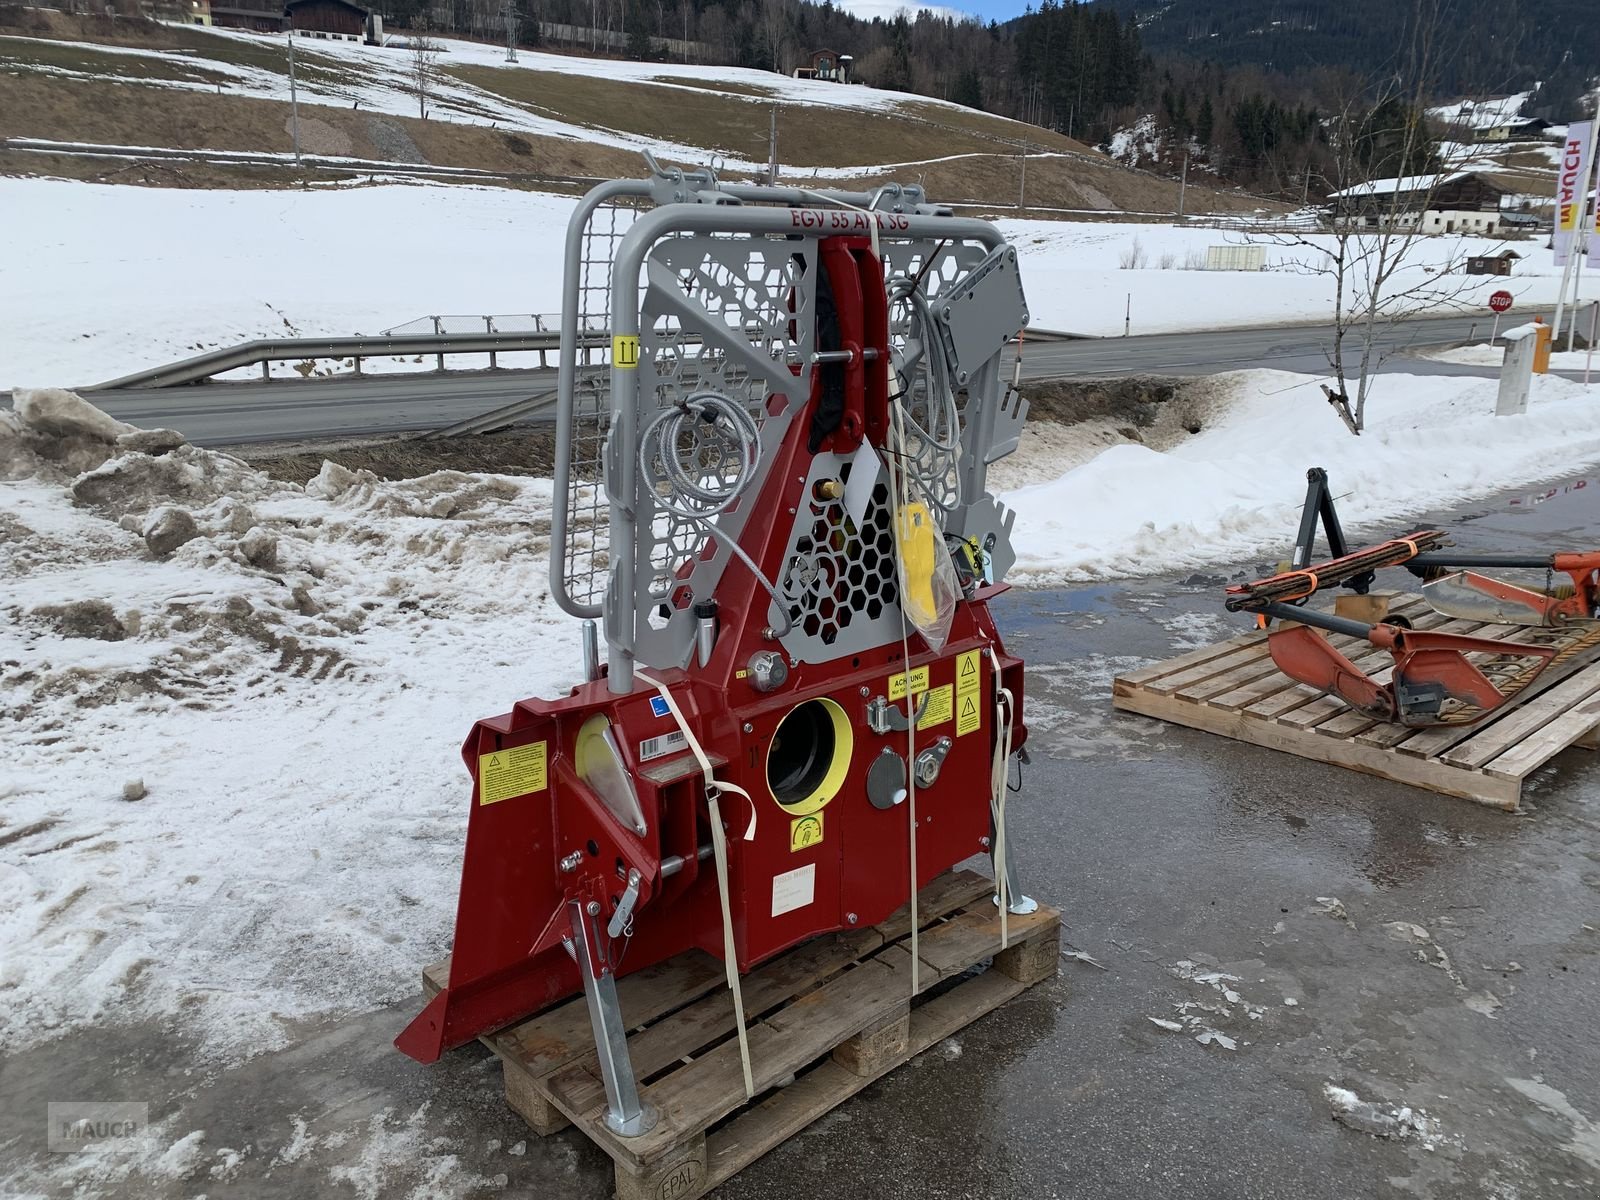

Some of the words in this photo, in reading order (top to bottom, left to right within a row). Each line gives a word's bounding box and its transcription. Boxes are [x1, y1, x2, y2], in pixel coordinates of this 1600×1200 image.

[1560, 140, 1580, 223] MAUCH
[791, 210, 824, 228] EGV
[831, 211, 849, 229] 55
[889, 214, 909, 230] SG
[1491, 297, 1511, 306] STOP
[894, 673, 924, 687] ACHUNG
[661, 1167, 696, 1200] EPAL
